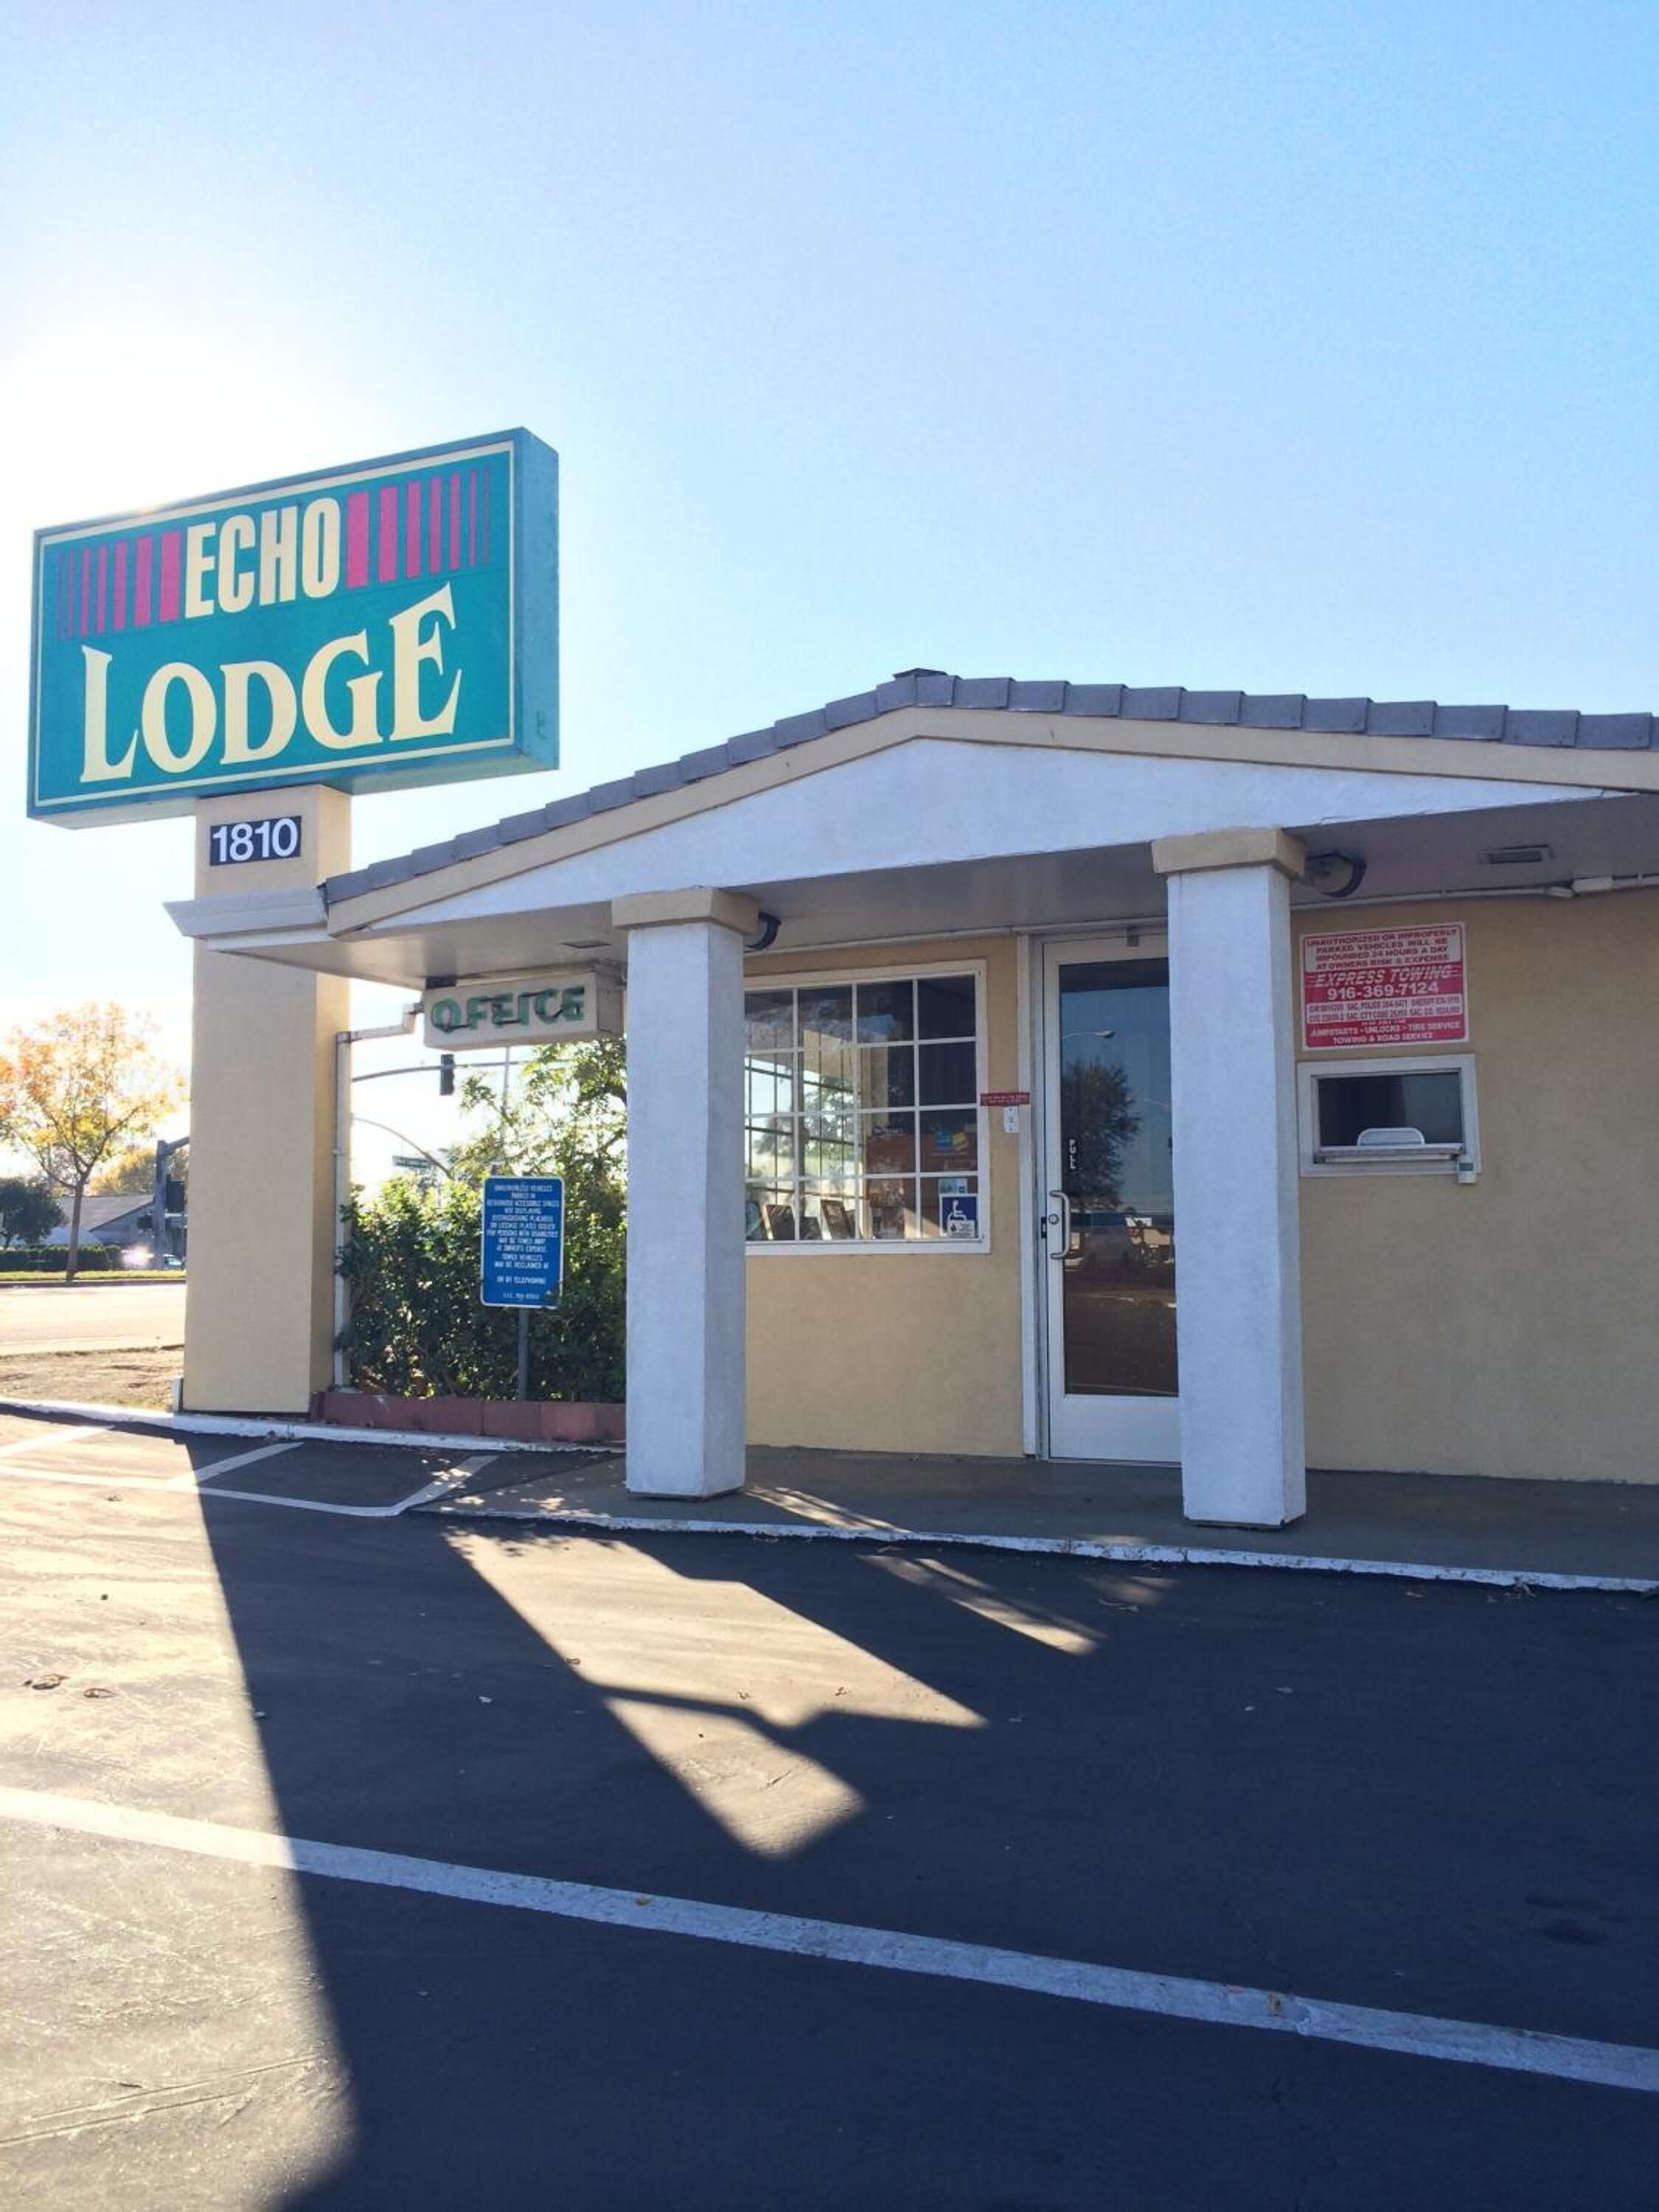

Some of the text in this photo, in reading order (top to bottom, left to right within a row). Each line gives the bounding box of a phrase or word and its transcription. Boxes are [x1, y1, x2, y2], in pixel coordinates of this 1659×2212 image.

[185, 497, 341, 619] ECHO
[80, 582, 462, 783] LODGE
[212, 818, 298, 861] 1810
[1398, 929, 1457, 939] IMPROPERLY
[1317, 945, 1354, 954] PARKED
[1358, 942, 1402, 950] VEHICLES
[1315, 965, 1453, 987] EXPRESS TOWING
[1327, 981, 1439, 1001] 916-369-7124
[431, 986, 585, 1034] OFFICE
[1402, 1032, 1433, 1040] SERVICE
